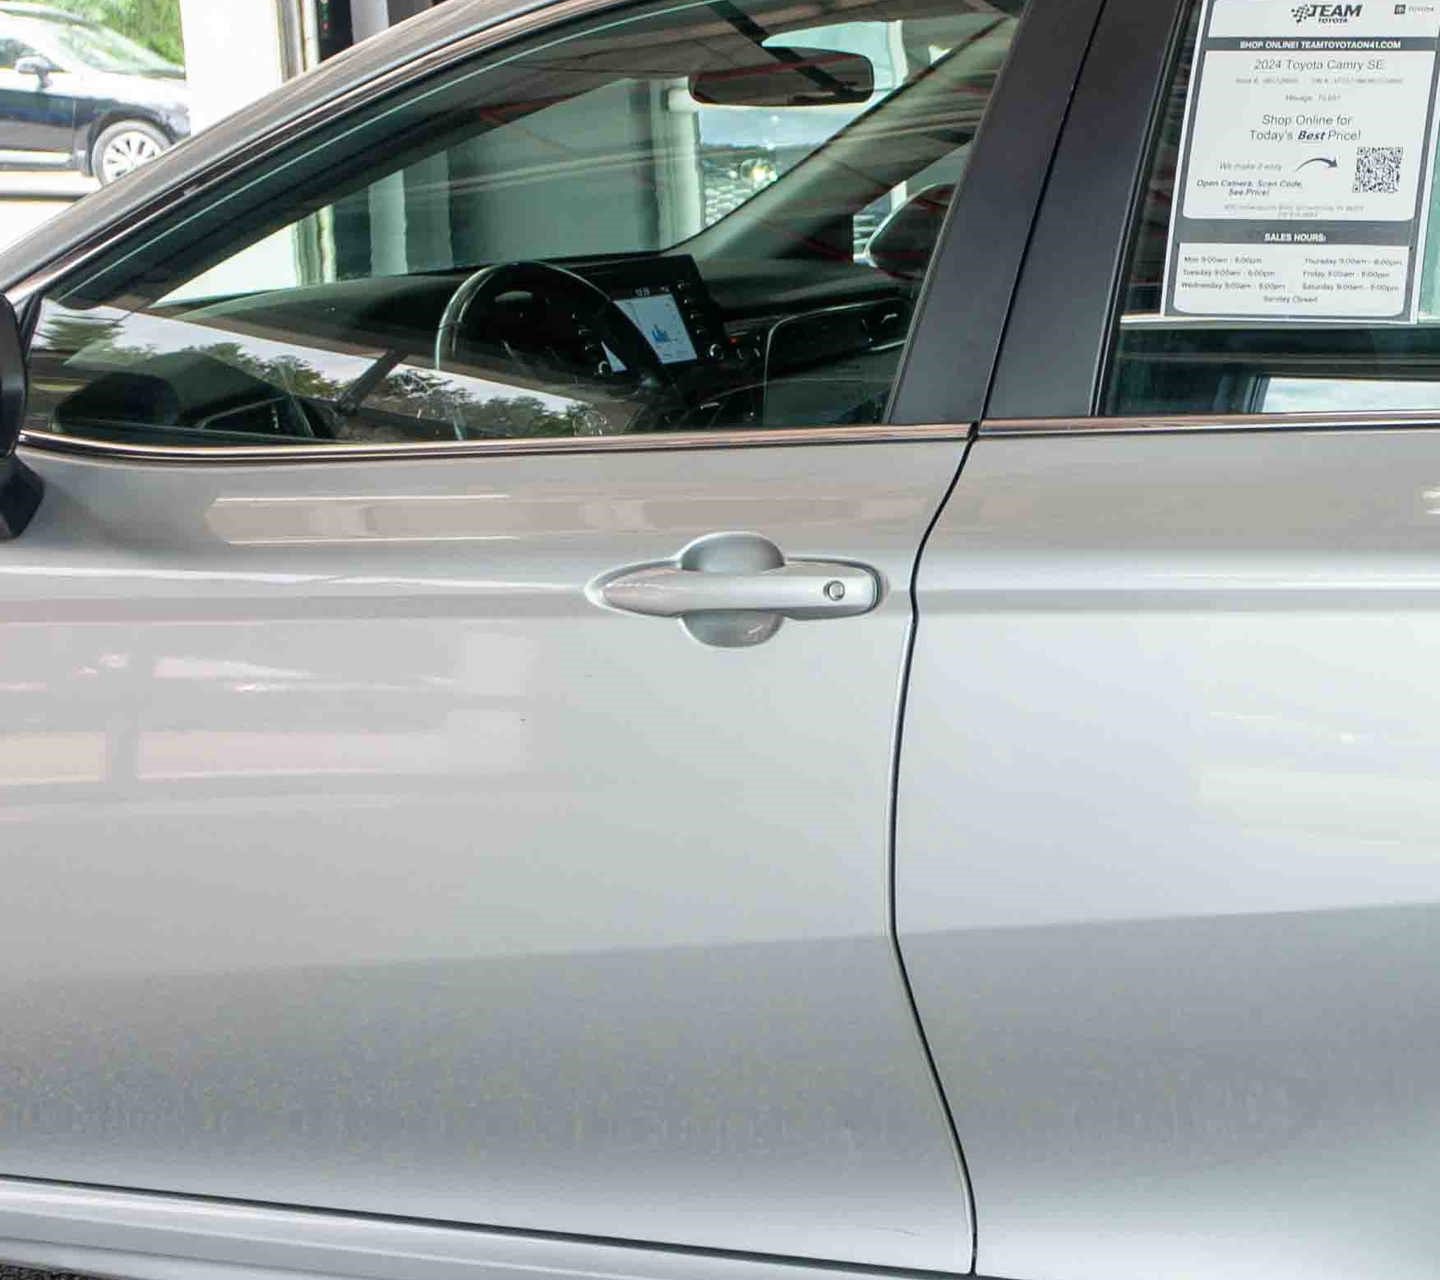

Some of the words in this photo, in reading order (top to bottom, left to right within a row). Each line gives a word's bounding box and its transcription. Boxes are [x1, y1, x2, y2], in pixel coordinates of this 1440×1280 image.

[1308, 4, 1363, 17] TEAM
[1240, 40, 1264, 49] SHOP
[1300, 40, 1401, 49] TEAMTOYOTAON41.COM
[1254, 59, 1282, 70] 2024
[1286, 59, 1324, 72] Toyota
[1327, 59, 1364, 72] Camry
[1367, 59, 1385, 70] SE
[1262, 114, 1291, 127] Shop
[1295, 114, 1334, 126] Online
[1336, 114, 1352, 126] for
[1249, 130, 1293, 142] Today's
[1297, 130, 1326, 141] Best
[1327, 130, 1361, 141] Price!
[1264, 233, 1292, 241] SALES
